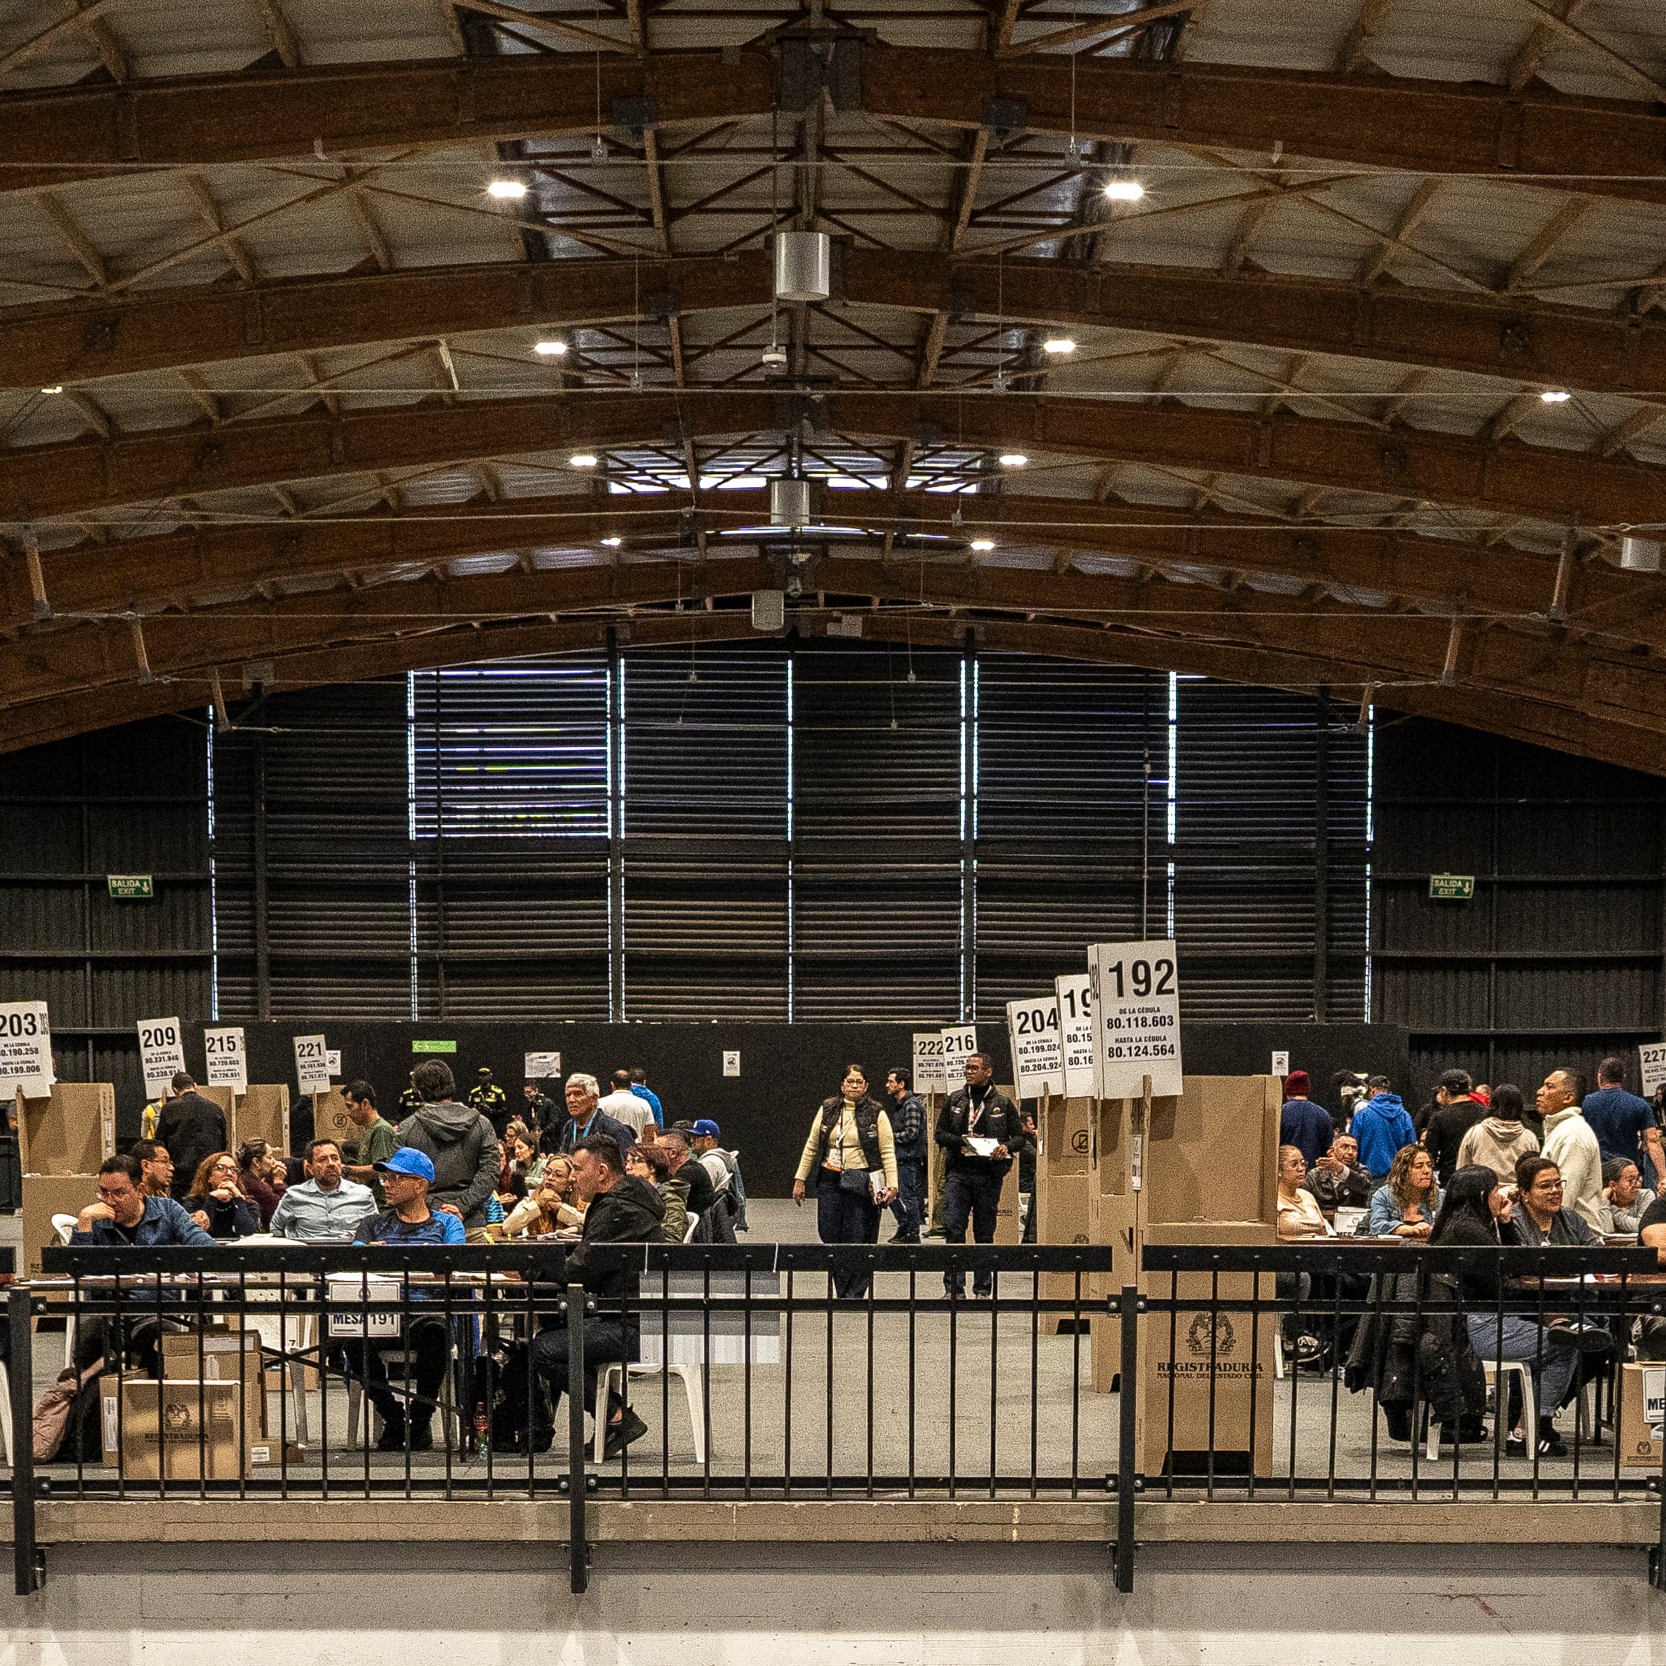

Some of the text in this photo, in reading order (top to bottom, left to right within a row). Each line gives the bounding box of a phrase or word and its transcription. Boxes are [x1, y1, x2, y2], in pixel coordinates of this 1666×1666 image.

[111, 879, 141, 888] SALIDA
[1433, 879, 1462, 888] SALIDA
[118, 887, 136, 896] EXIT
[1438, 888, 1457, 896] EXIT
[1108, 958, 1176, 999] 192
[1118, 1007, 1128, 1016] DE
[1128, 1007, 1137, 1015] LA
[1016, 1007, 1059, 1036] 204
[1106, 1015, 1175, 1030] 80.118.603
[142, 1027, 176, 1049] 209
[206, 1035, 237, 1053] 215
[944, 1035, 974, 1053] 216
[1114, 1036, 1135, 1045] HASTA
[297, 1041, 323, 1058] 221
[918, 1041, 943, 1056] 222
[1107, 1043, 1176, 1059] 80.124.564
